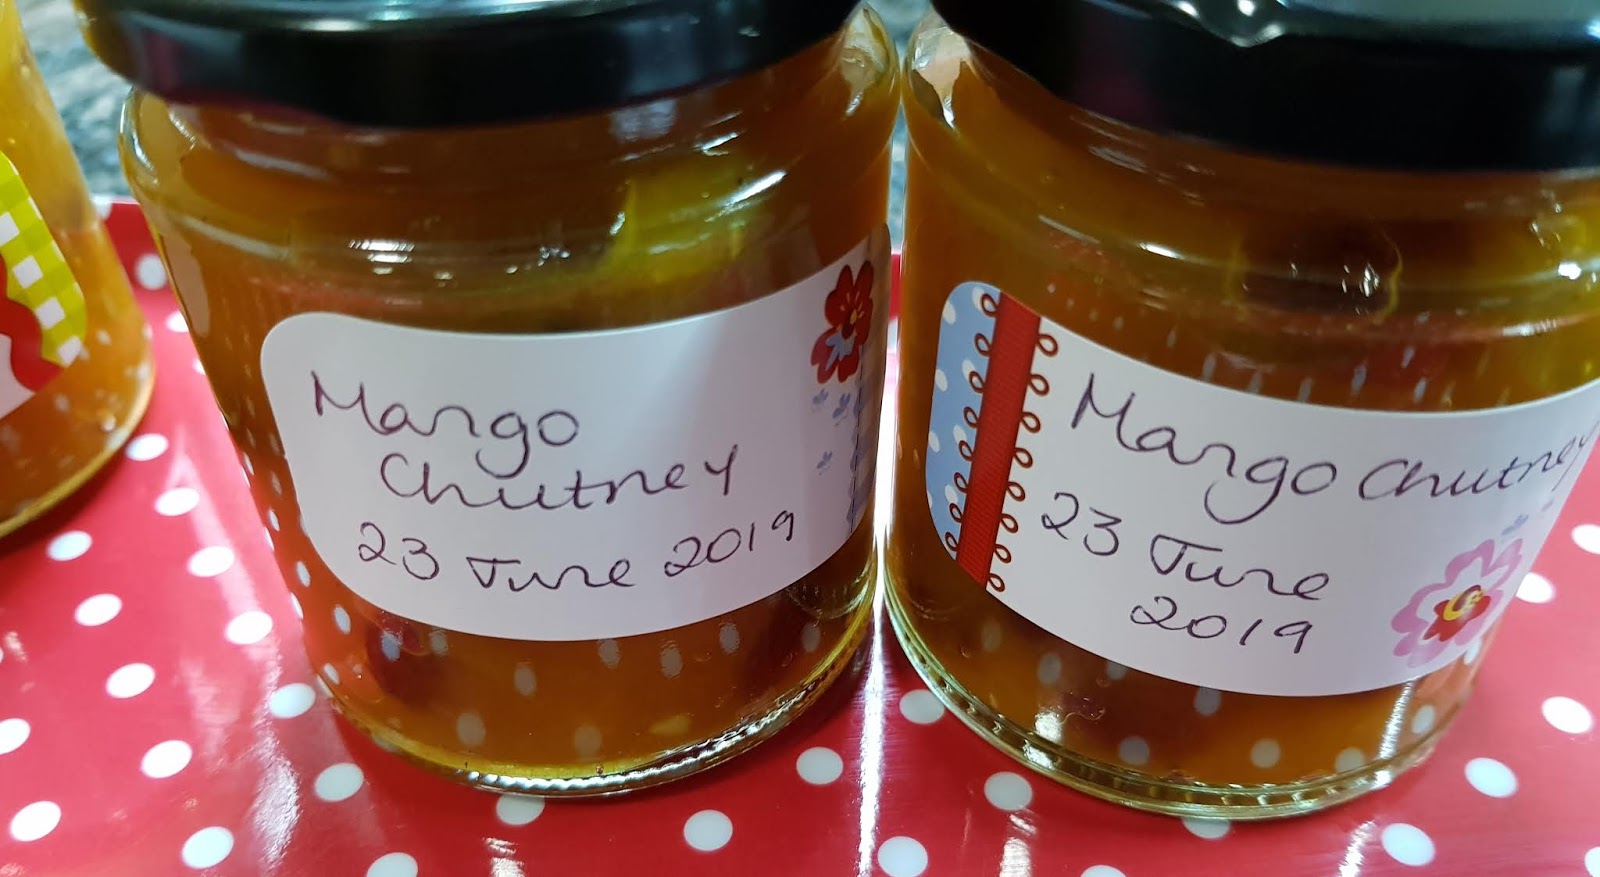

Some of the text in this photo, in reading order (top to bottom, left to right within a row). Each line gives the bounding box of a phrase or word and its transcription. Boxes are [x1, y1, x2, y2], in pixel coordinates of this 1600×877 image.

[310, 370, 580, 479] Mango
[1071, 372, 1600, 525] Mango Chutney
[380, 443, 738, 509] Chutney
[357, 509, 795, 592] 23 June 2019
[1041, 491, 1330, 601] 23 June
[1129, 595, 1314, 654] 2019
